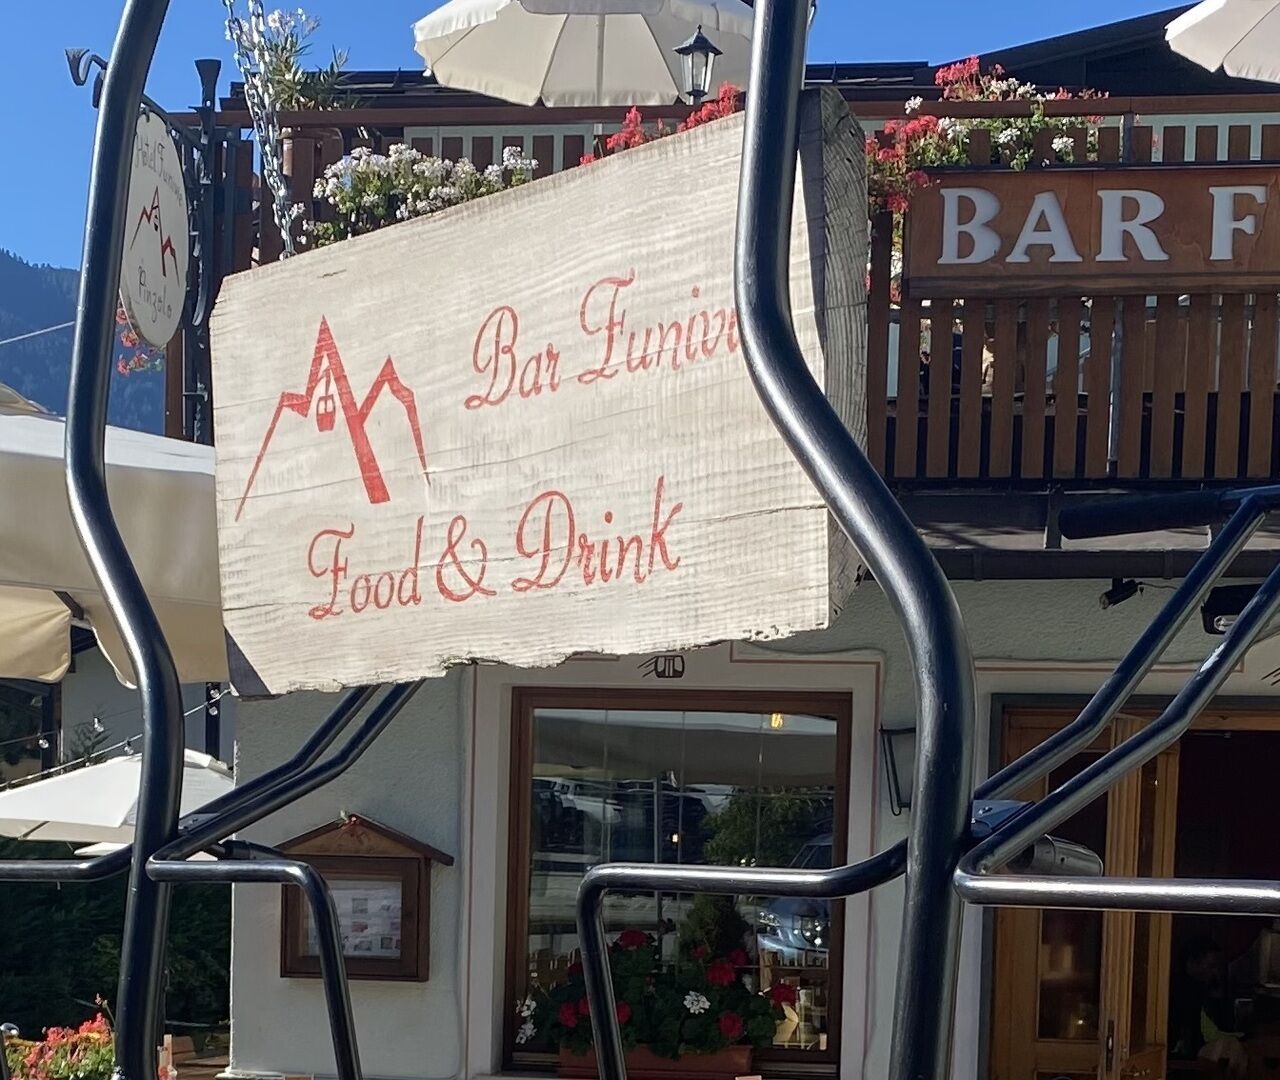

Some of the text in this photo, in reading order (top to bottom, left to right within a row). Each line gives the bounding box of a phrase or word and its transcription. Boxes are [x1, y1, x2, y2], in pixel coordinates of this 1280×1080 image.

[134, 134, 157, 173] Hotel
[935, 186, 1171, 266] BAR
[138, 265, 172, 323] Pinzolo
[464, 268, 738, 411] Bar Funivi
[308, 475, 684, 620] Food & Drink
